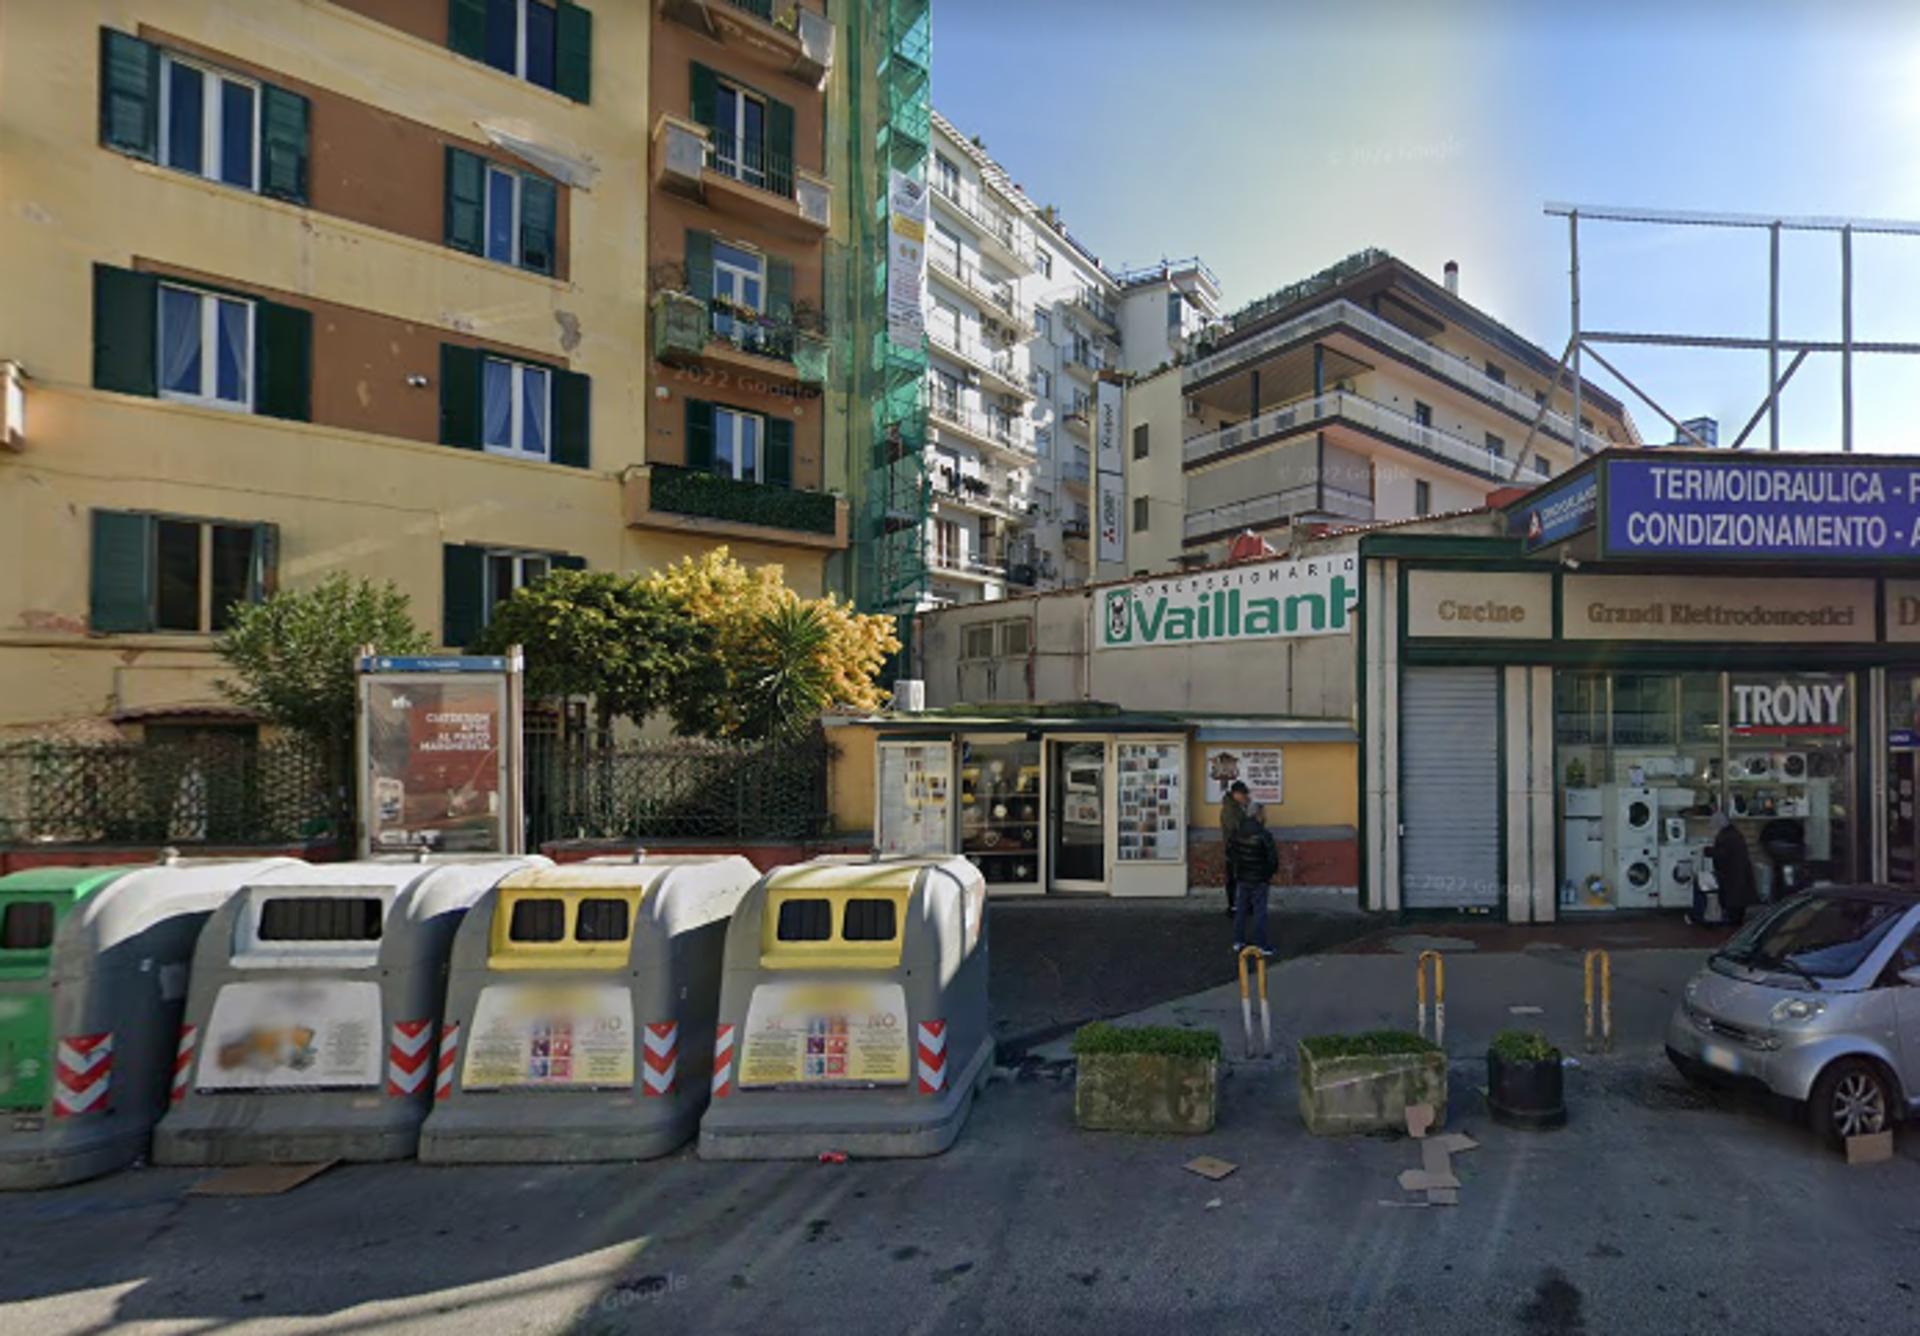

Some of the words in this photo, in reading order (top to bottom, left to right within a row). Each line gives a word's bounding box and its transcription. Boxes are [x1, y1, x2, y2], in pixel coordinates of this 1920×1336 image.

[1650, 468, 1885, 503] TERMOIDRAULICA
[1627, 513, 1887, 547] CONDIZIONAMENTO
[1133, 575, 1356, 642] Vaillant
[1438, 600, 1525, 623] Cucine
[1587, 603, 1663, 624] Grandi
[1671, 604, 1854, 627] Elettrodomestici
[1733, 685, 1844, 725] TRONY
